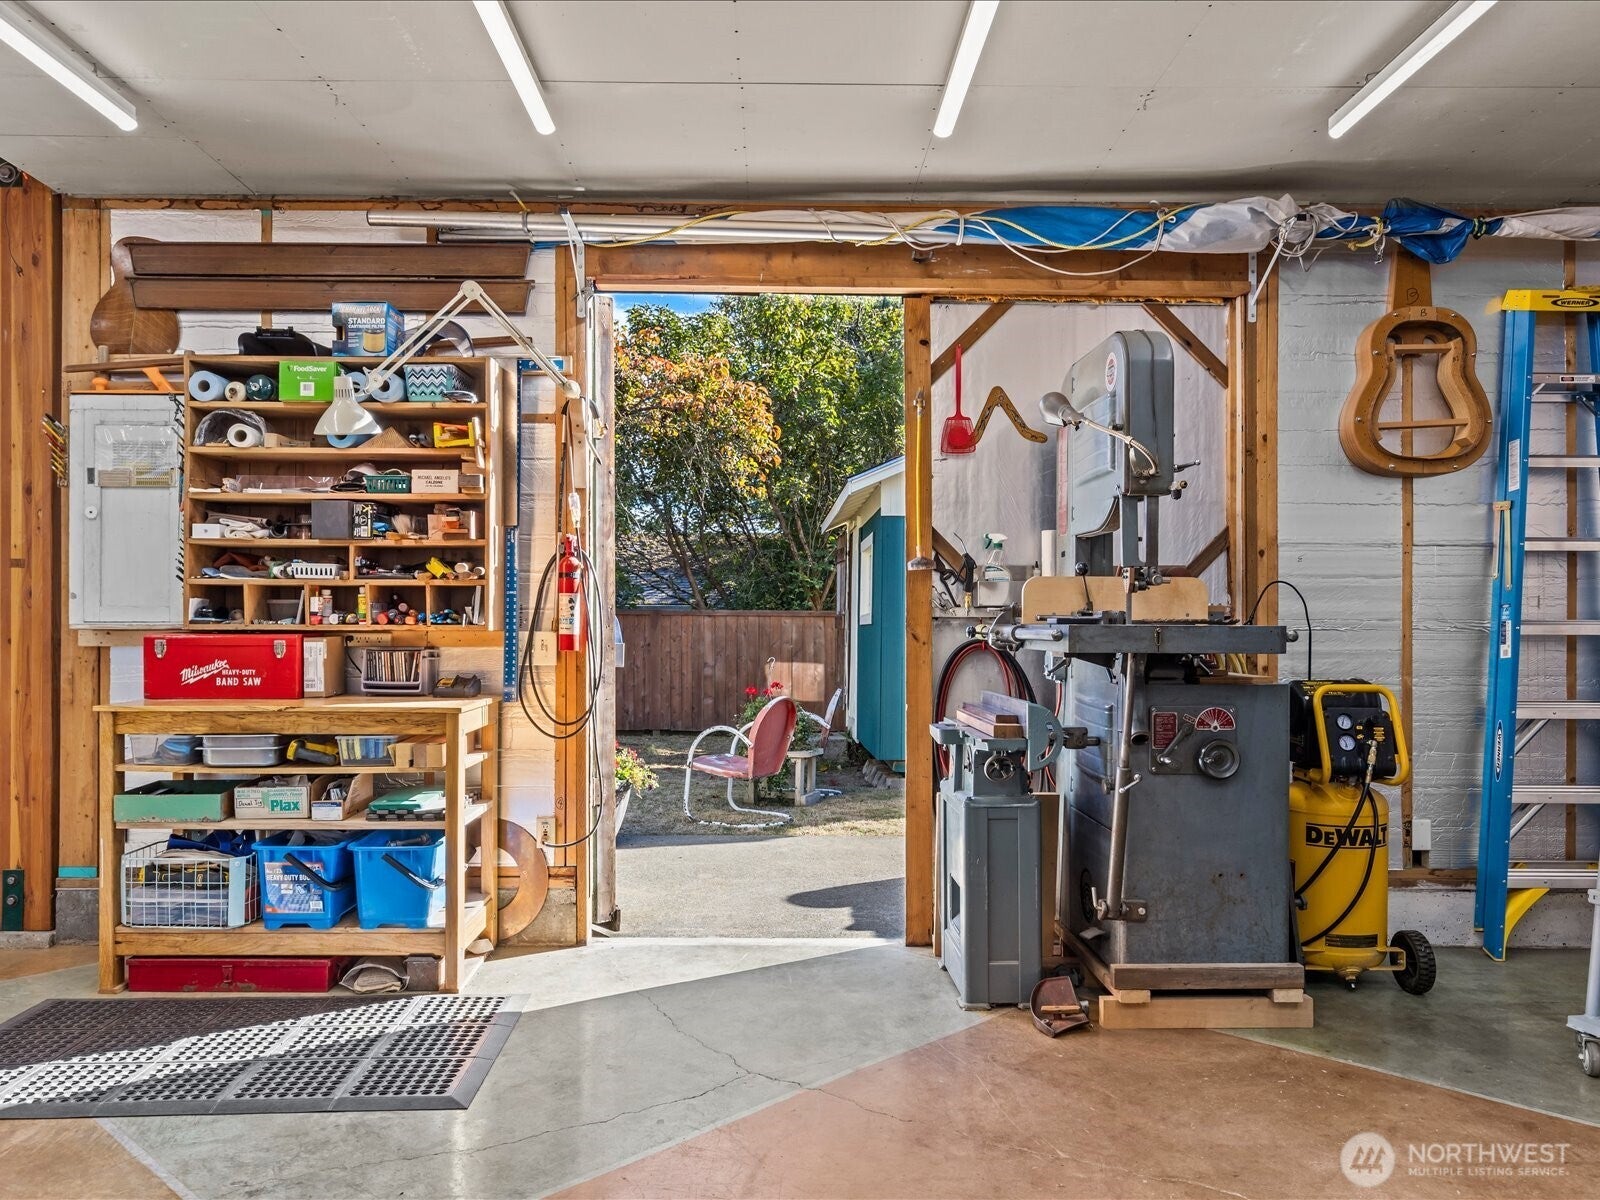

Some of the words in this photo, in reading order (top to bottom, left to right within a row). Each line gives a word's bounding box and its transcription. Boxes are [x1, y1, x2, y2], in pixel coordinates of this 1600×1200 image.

[1420, 308, 1427, 317] B
[348, 317, 386, 325] STANDARD
[293, 364, 327, 372] FoodSaver
[180, 658, 230, 682] Milwaukee
[215, 677, 239, 687] BAND
[242, 677, 262, 687] SAW
[270, 799, 300, 812] Plax
